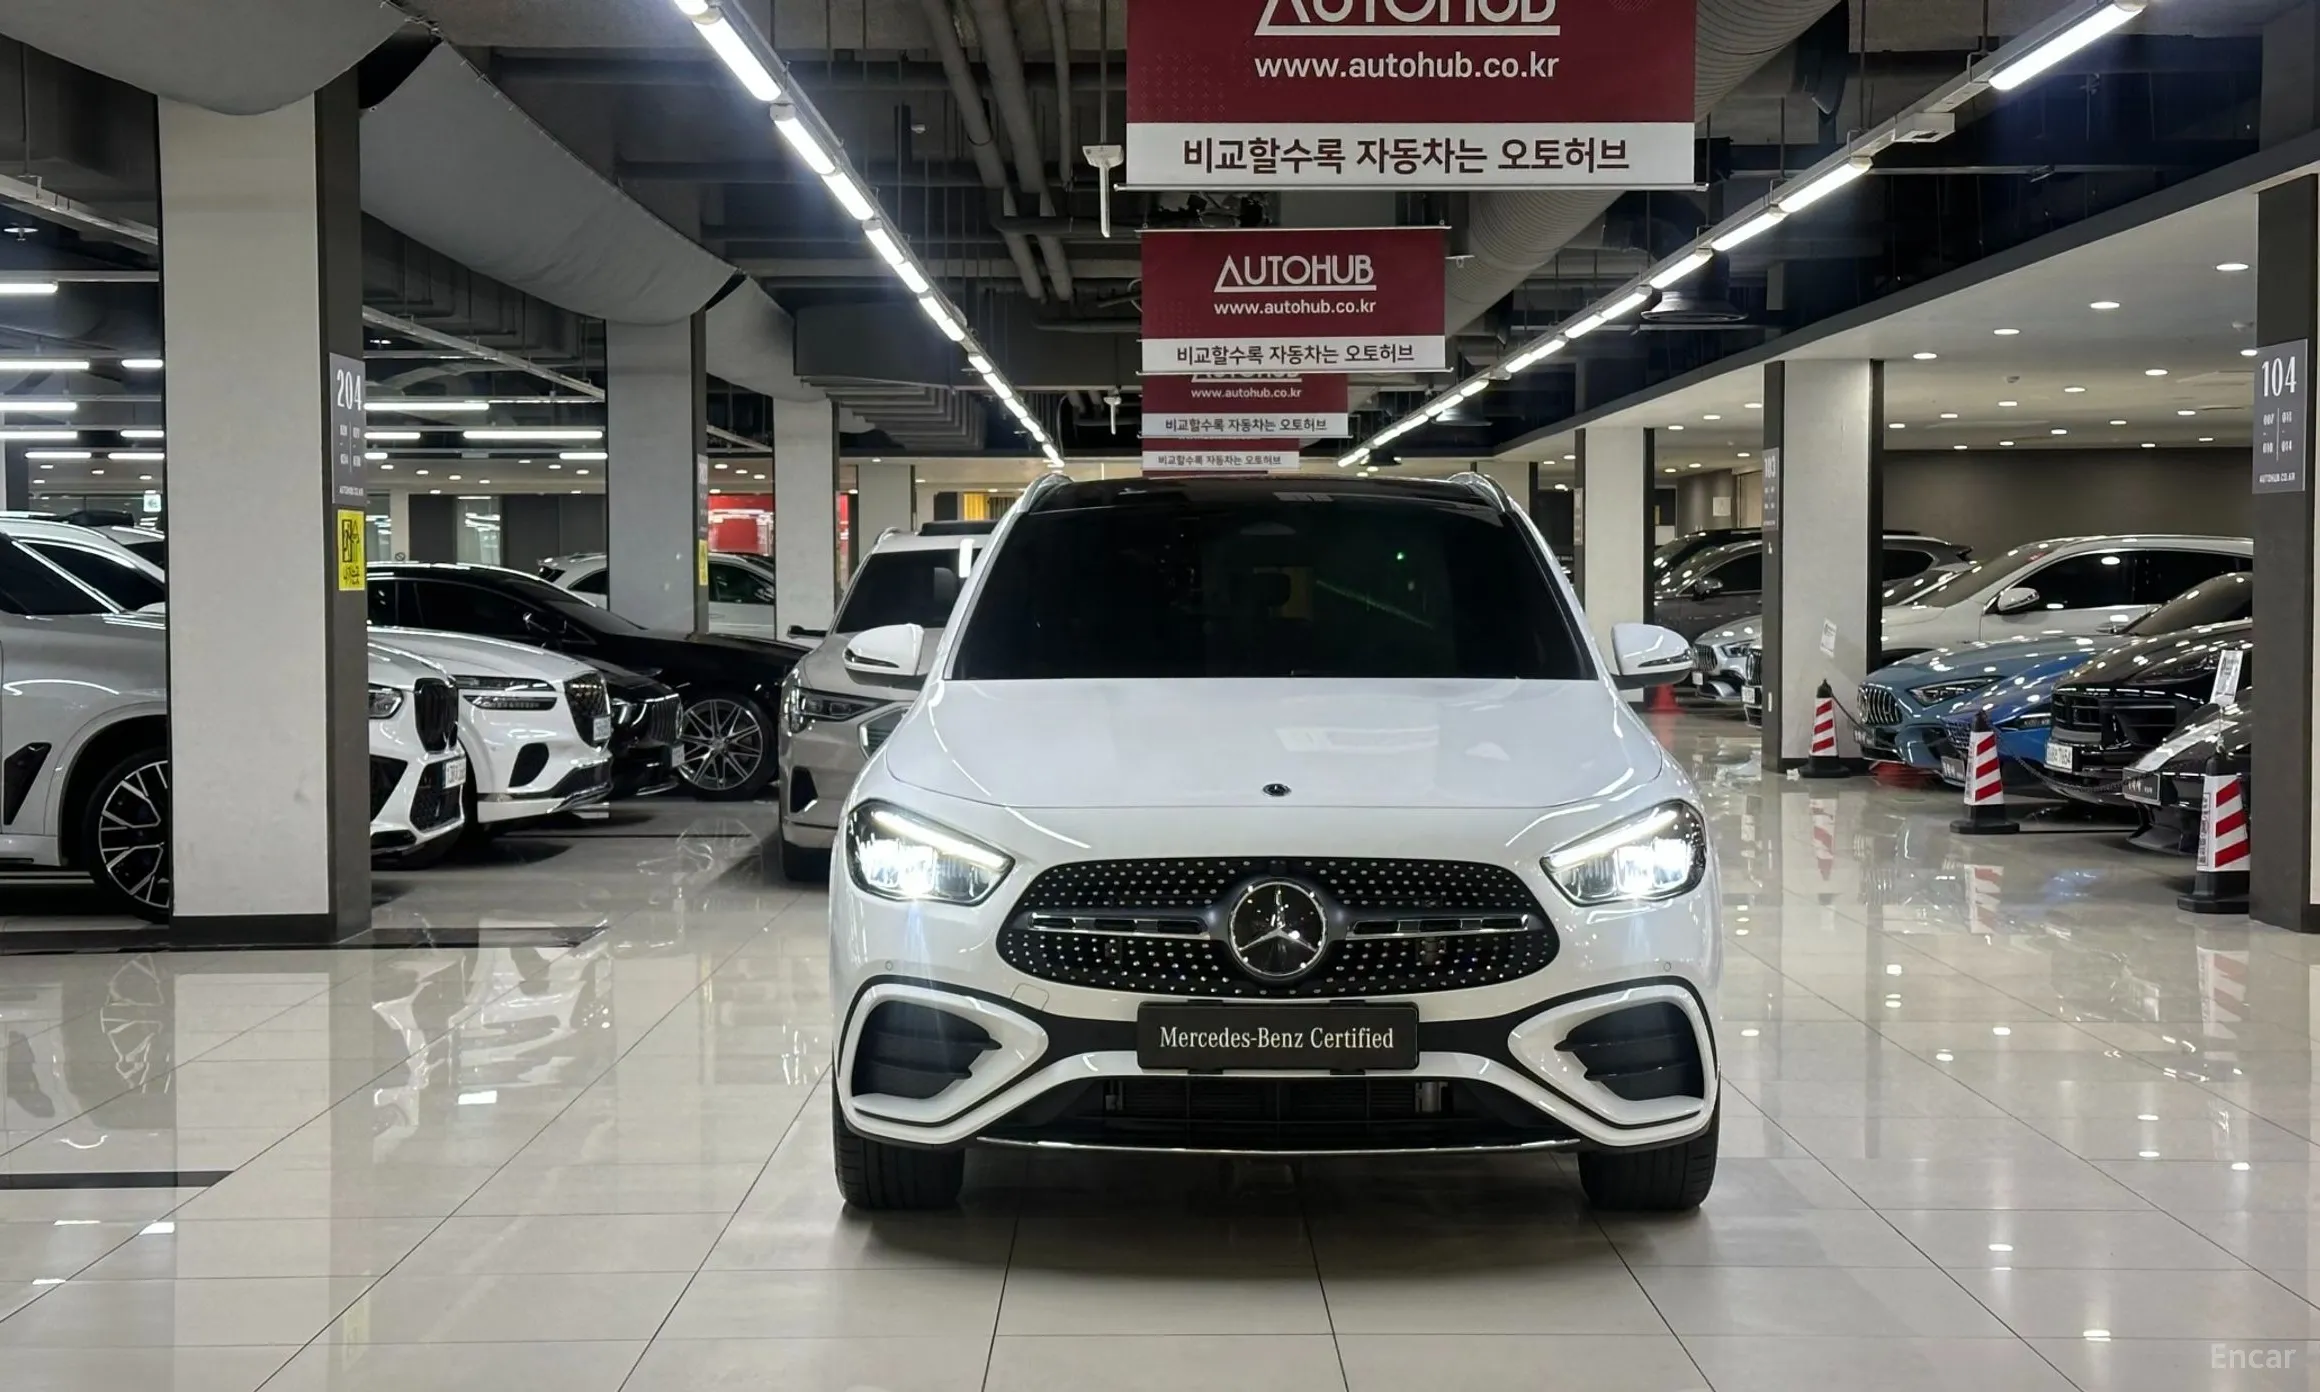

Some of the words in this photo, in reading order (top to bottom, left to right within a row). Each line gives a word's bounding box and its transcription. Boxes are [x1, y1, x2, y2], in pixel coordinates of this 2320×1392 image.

[1254, 50, 1560, 78] www.autohub.co.kr
[1183, 137, 1345, 175] 비교할수록
[1356, 137, 1488, 175] 자동차는
[1498, 137, 1630, 174] 오토허브
[1213, 254, 1377, 293] AUTOHUB
[1213, 298, 1377, 315] www.autohub.co.kr
[1177, 345, 1264, 366] 비교할수록
[1269, 344, 1339, 365] 자동차는
[1344, 343, 1415, 363] 오토허브
[2261, 356, 2297, 397] 104
[336, 368, 362, 411] 204
[1190, 387, 1302, 399] www.autohub.co.kr
[1165, 418, 1225, 433] 비교할수록
[1228, 418, 1277, 433] 자동차는
[1279, 417, 1328, 432] 오토허브
[1160, 1026, 1304, 1049] Mercedes-Benz
[1310, 1027, 1394, 1049] Certified
